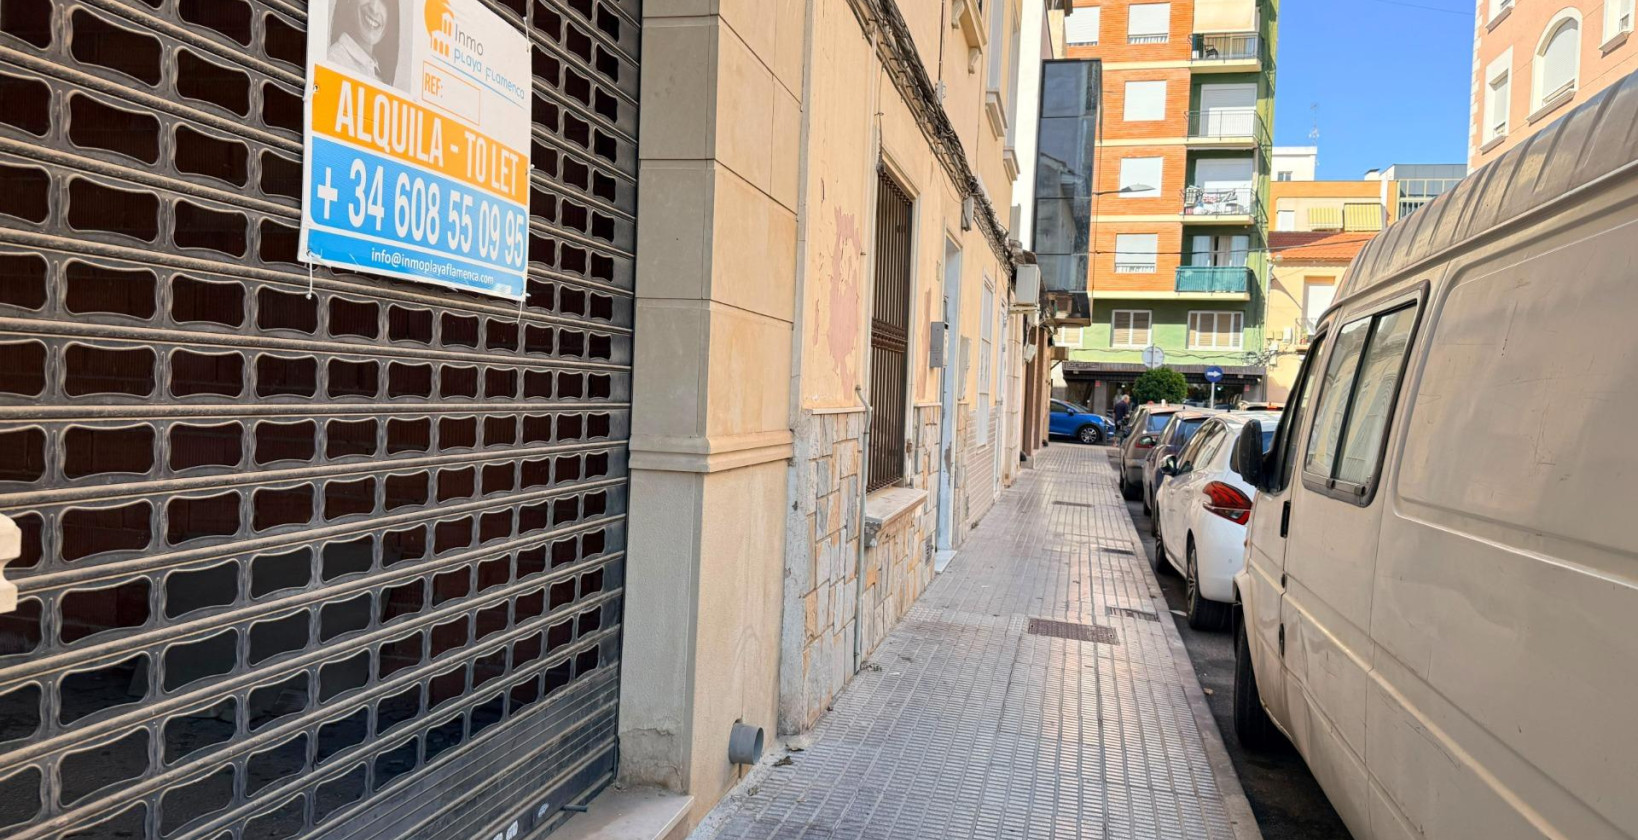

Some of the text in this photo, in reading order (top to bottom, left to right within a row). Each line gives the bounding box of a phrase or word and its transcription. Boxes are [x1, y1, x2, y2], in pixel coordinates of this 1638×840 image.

[454, 23, 484, 56] Inmo
[424, 72, 443, 98] REF:
[334, 79, 444, 168] ALQUILA
[464, 130, 487, 183] TO
[490, 143, 519, 196] LET
[348, 158, 385, 231] 34
[394, 172, 440, 245] 608
[447, 189, 473, 253] 55
[479, 200, 501, 261] 09
[505, 210, 524, 267] 95
[370, 247, 495, 284] info@inmoplayaflamenca.com
